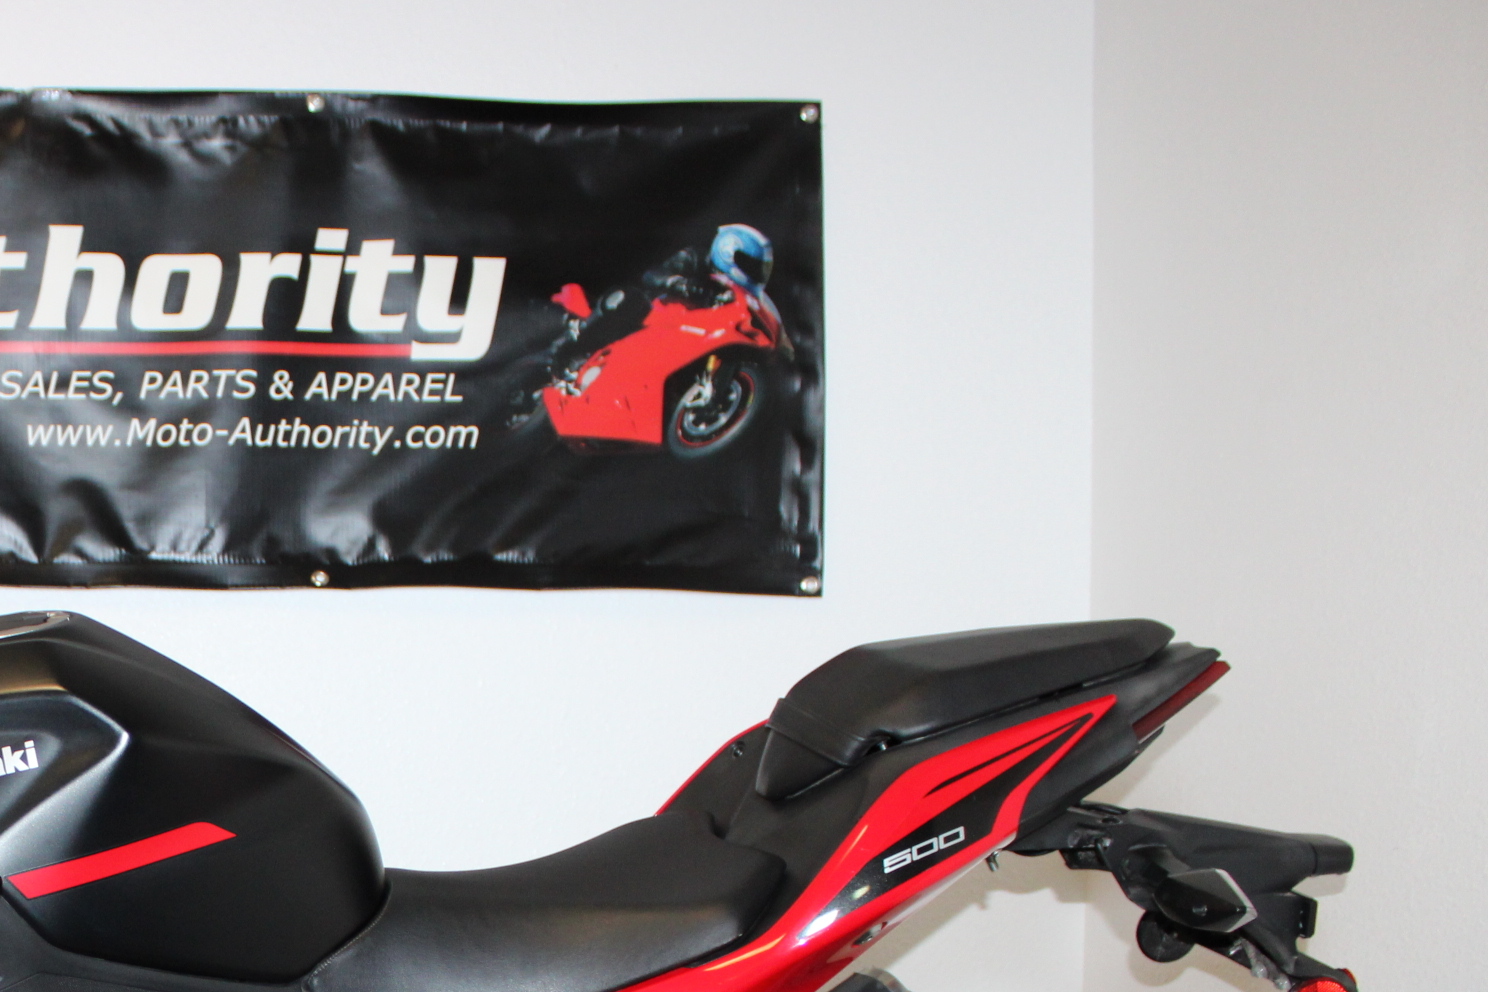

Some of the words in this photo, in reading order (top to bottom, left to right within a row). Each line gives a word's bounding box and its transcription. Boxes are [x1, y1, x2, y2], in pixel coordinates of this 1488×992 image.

[139, 370, 257, 400] PARTS
[269, 370, 293, 399] &
[305, 372, 464, 402] APPAREL
[26, 417, 479, 453] www.Moto-Authority.com
[883, 826, 965, 874] 500
